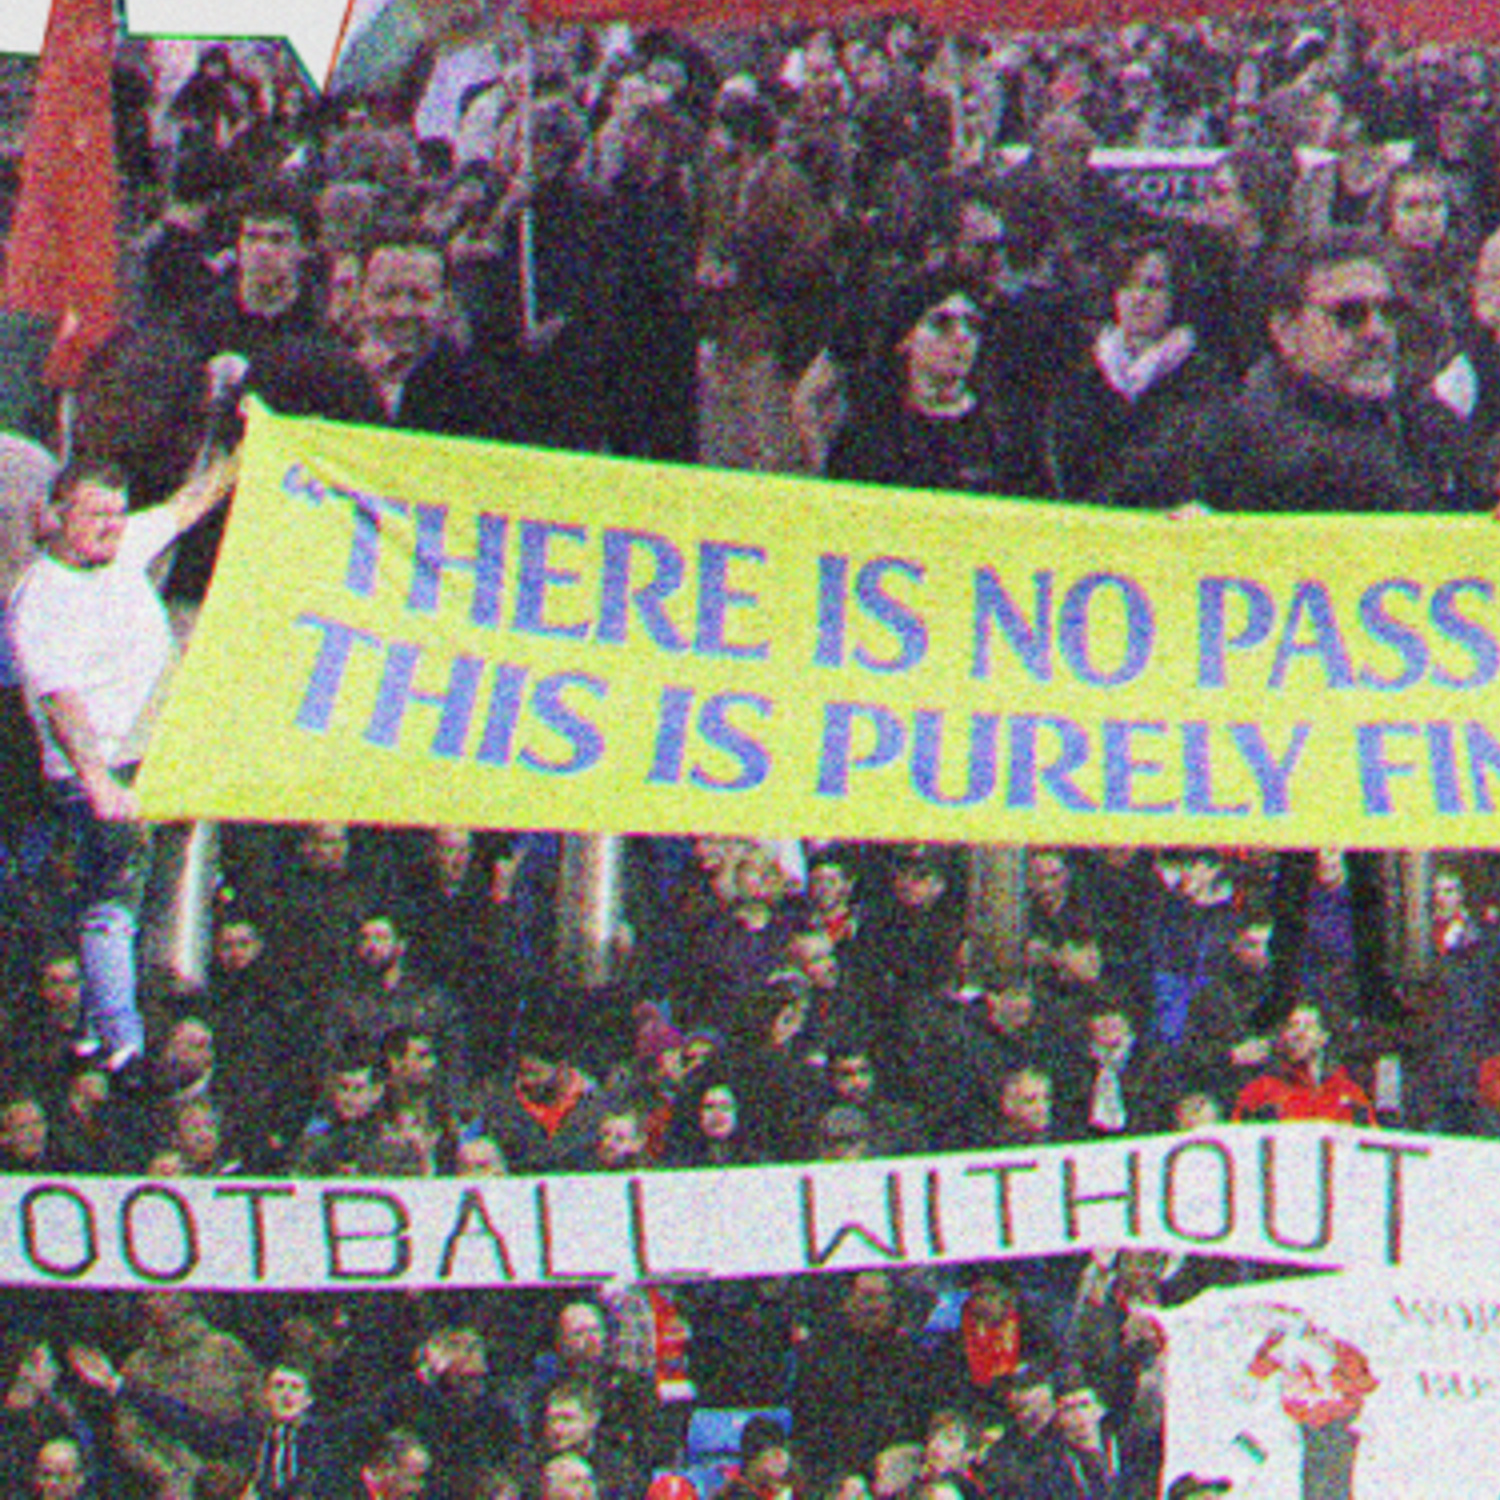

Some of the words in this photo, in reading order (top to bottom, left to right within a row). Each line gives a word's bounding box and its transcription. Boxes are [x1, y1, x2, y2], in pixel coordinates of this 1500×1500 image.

[813, 552, 929, 674] IS
[970, 563, 1158, 688] NO
[294, 611, 610, 777] THIS
[644, 682, 776, 792] IS
[813, 700, 1313, 817] PURELY
[801, 1134, 1434, 1268] WITHOUT
